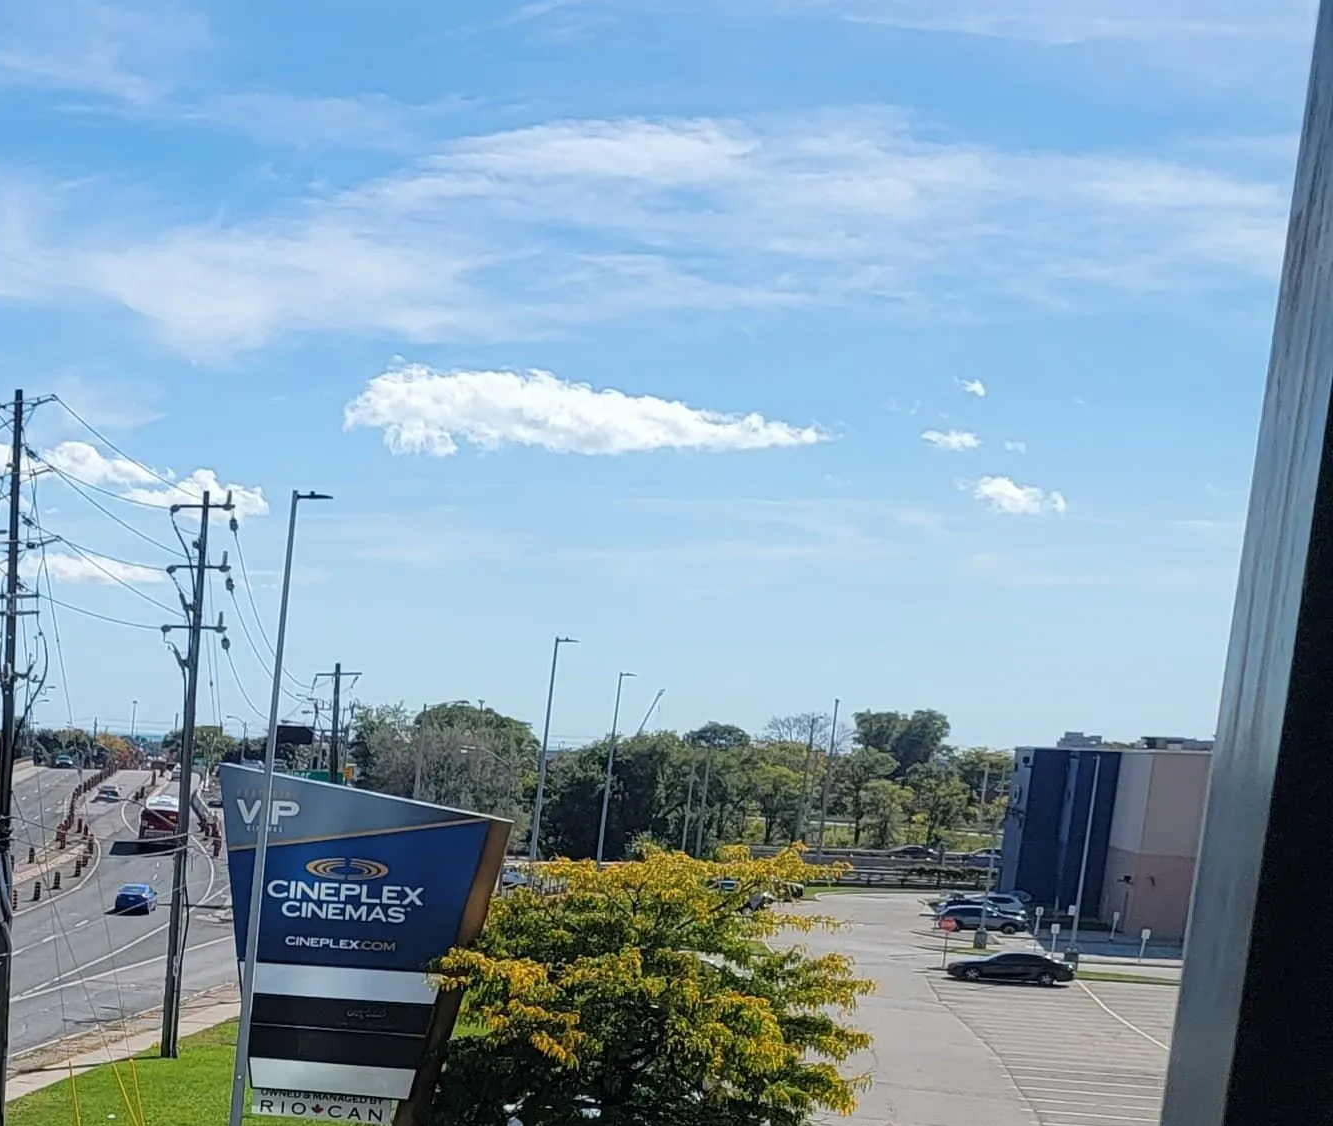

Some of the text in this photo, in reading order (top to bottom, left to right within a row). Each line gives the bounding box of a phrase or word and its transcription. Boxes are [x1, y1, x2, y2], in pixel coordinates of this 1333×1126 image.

[236, 798, 300, 825] VP
[267, 879, 424, 906] CINEPLEX
[281, 901, 406, 924] CINEMAS
[284, 935, 397, 952] CINEPLEX.COM
